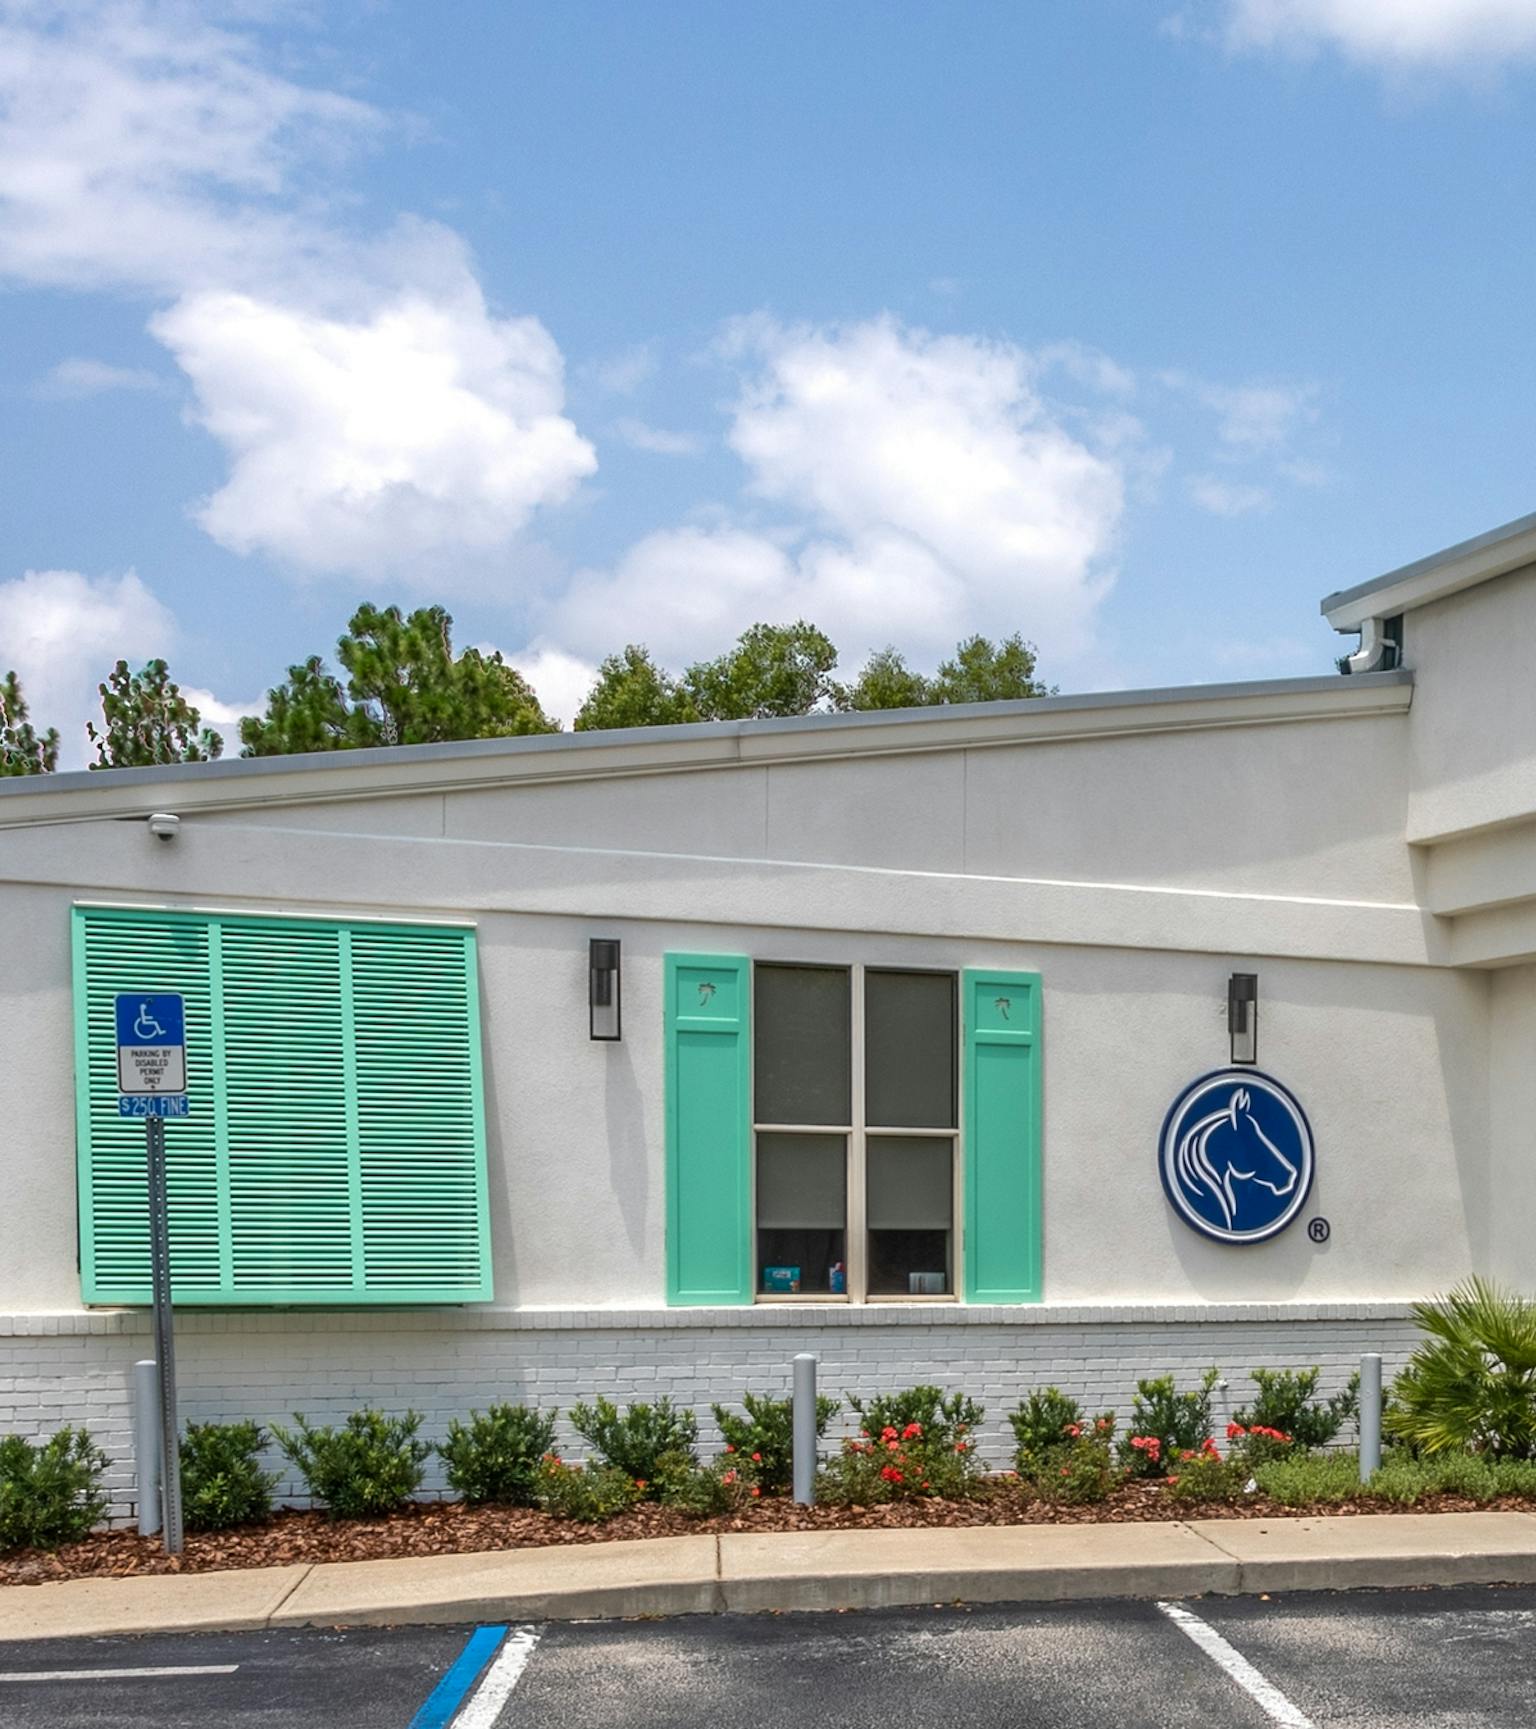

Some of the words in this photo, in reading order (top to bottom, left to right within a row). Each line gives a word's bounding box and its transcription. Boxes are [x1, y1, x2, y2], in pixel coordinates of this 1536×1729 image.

[135, 1059, 169, 1067] DISABLED
[144, 1077, 161, 1085] ONLY
[160, 1097, 187, 1115] FINE
